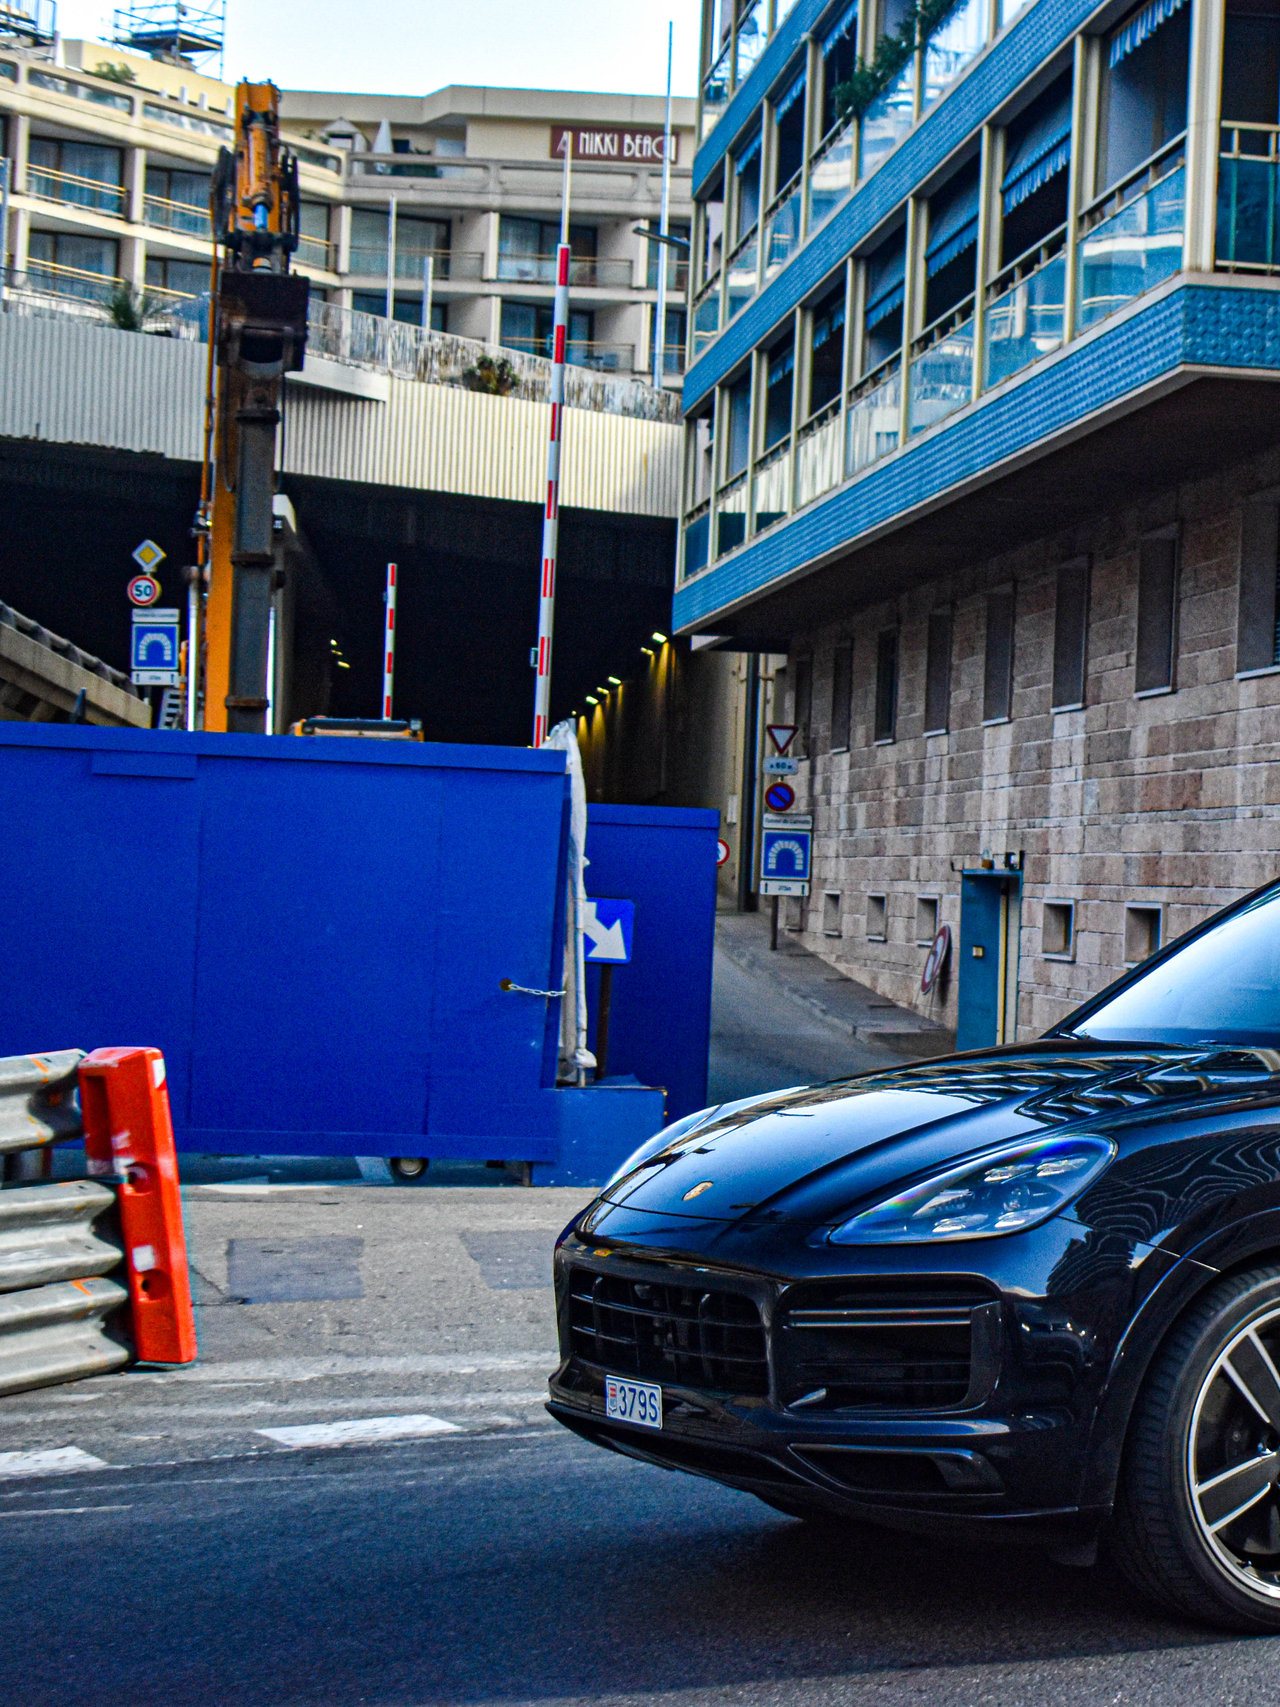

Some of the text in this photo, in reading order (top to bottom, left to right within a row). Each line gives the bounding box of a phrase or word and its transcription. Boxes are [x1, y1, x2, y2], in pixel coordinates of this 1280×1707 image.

[579, 132, 618, 155] NIKKI
[134, 584, 152, 597] 50
[619, 1385, 659, 1422] 379S
